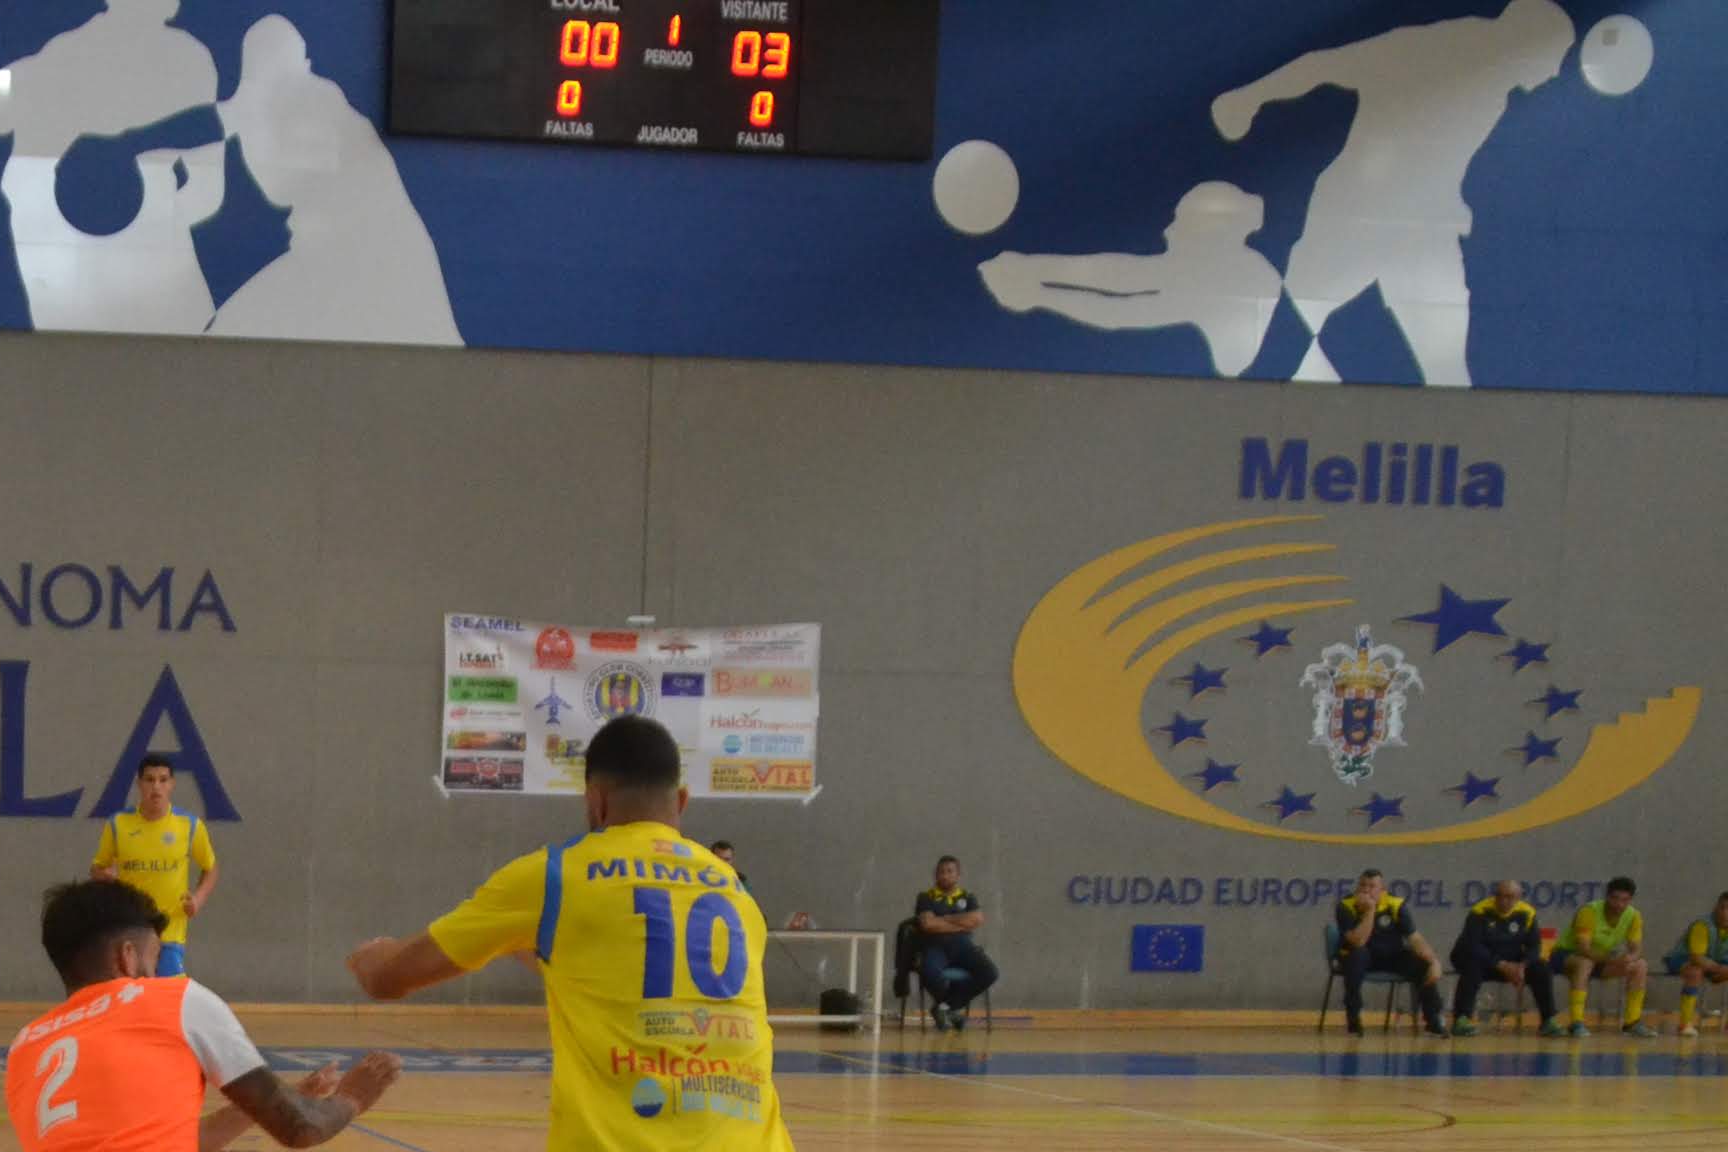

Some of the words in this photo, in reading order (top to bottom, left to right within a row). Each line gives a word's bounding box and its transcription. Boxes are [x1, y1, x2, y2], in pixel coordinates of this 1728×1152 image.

[721, 1, 788, 20] VISITANTE
[560, 20, 620, 68] 00
[669, 14, 681, 47] 1
[643, 48, 693, 68] PERIODO
[731, 30, 790, 78] 03
[556, 80, 581, 117] 0
[749, 90, 774, 127] 0
[545, 120, 593, 137] FALTAS
[637, 125, 698, 145] JUGADOR
[737, 131, 784, 148] FALTAS
[1239, 437, 1505, 508] Melilla
[450, 615, 527, 632] SEAMEL
[1067, 876, 1204, 906] CIUDAD
[1214, 877, 1362, 908] EUROPE
[1388, 879, 1454, 909] DEL
[632, 886, 749, 1000] 10
[611, 1042, 729, 1078] Halcón
[35, 1035, 79, 1139] 2
